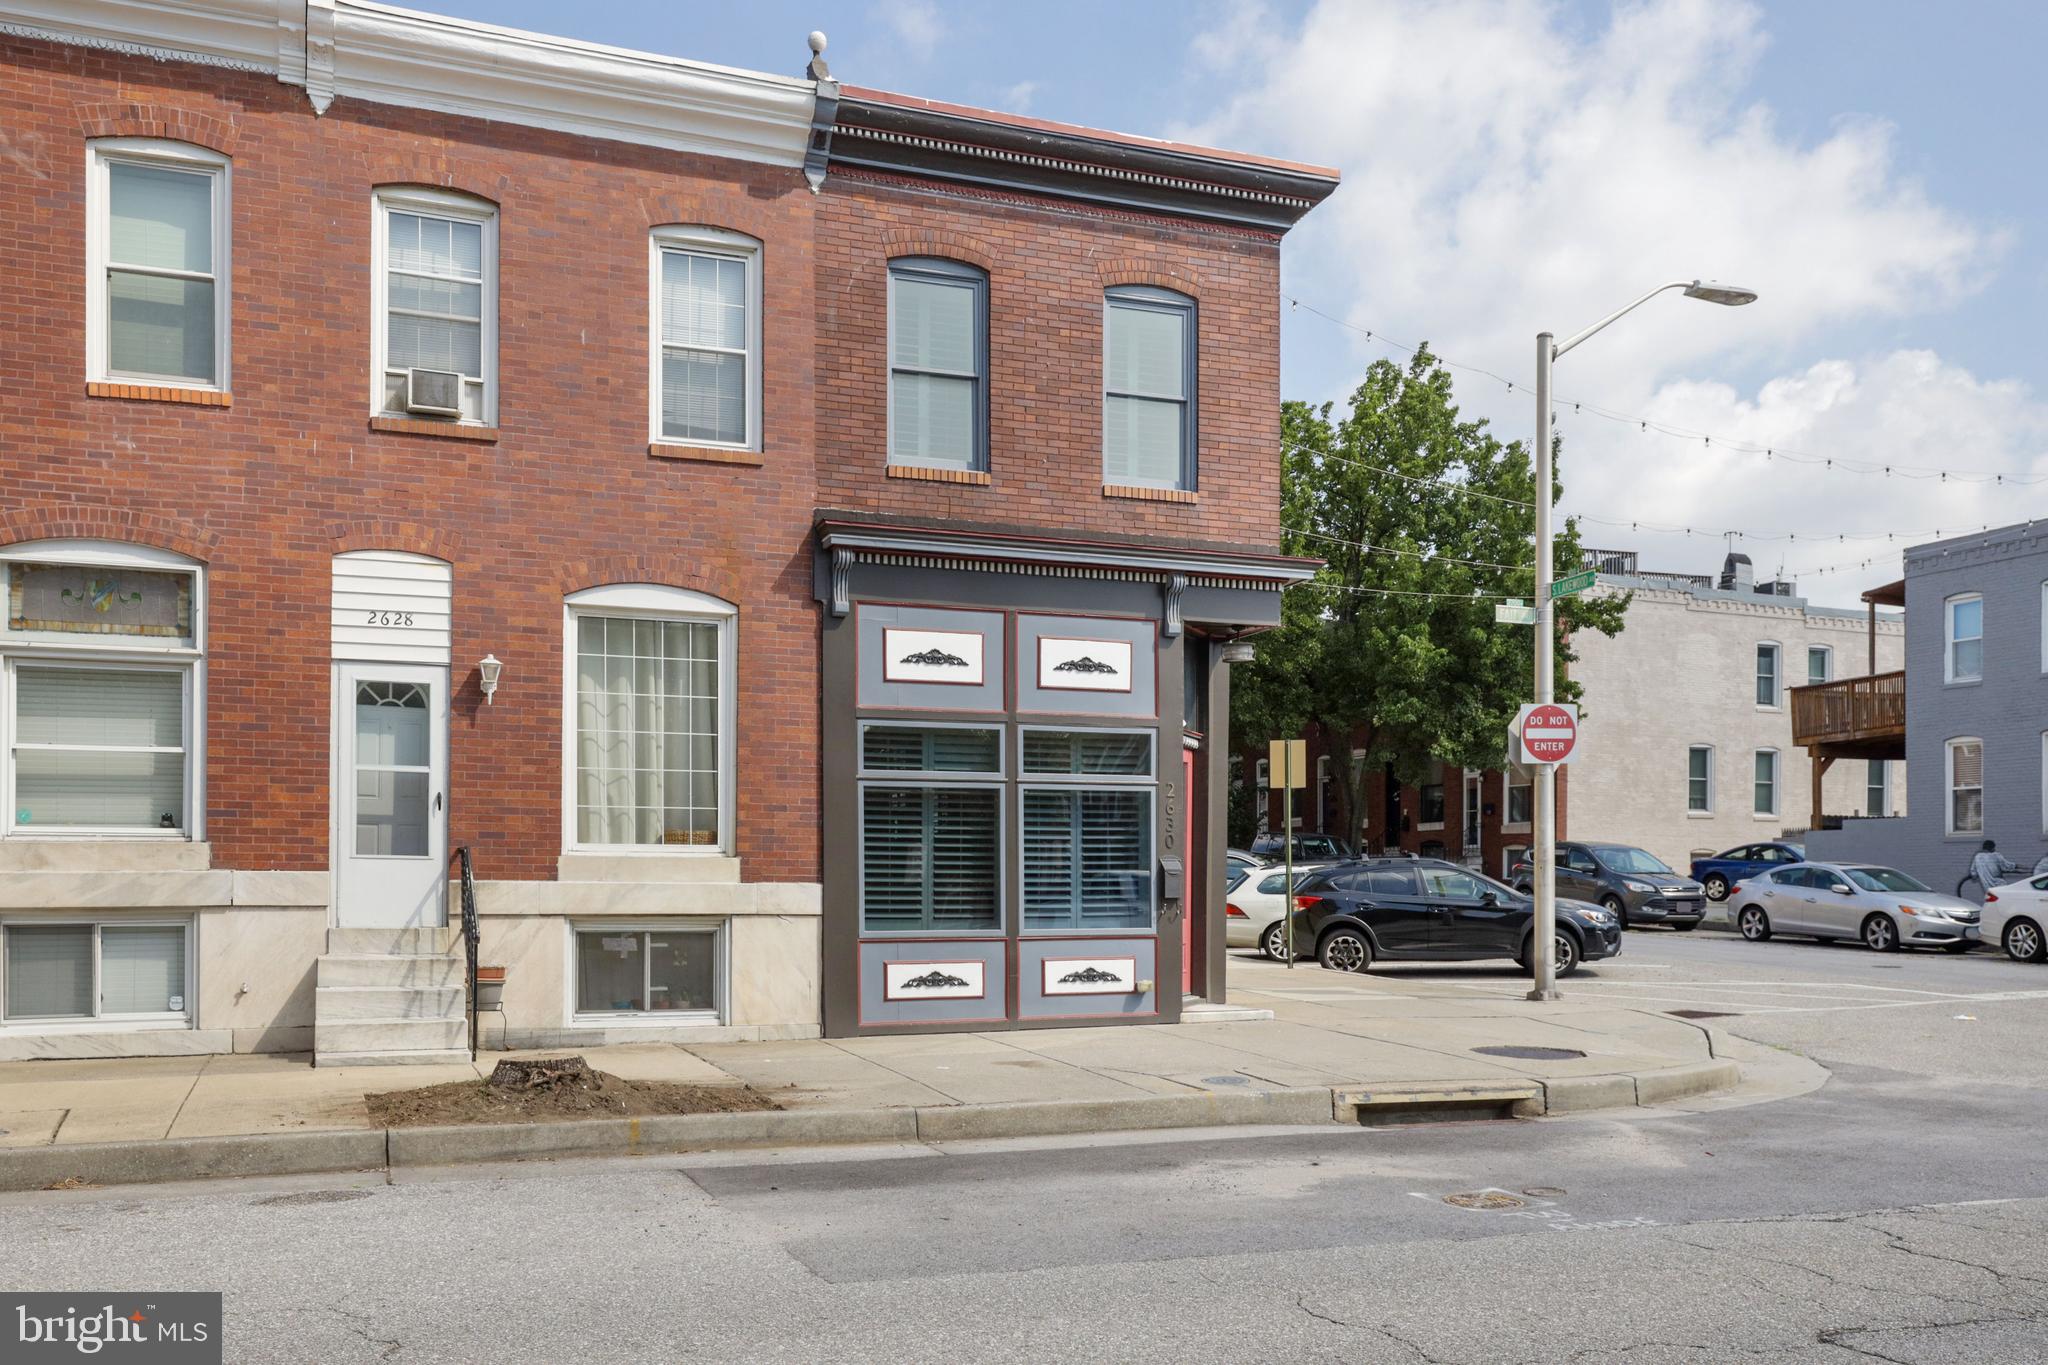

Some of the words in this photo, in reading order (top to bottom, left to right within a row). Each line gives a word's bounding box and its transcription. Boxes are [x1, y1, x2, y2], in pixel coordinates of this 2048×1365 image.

[368, 610, 413, 627] 2628
[1530, 716, 1543, 725] DO
[1549, 716, 1568, 725] NOT
[1534, 742, 1565, 751] ENTER
